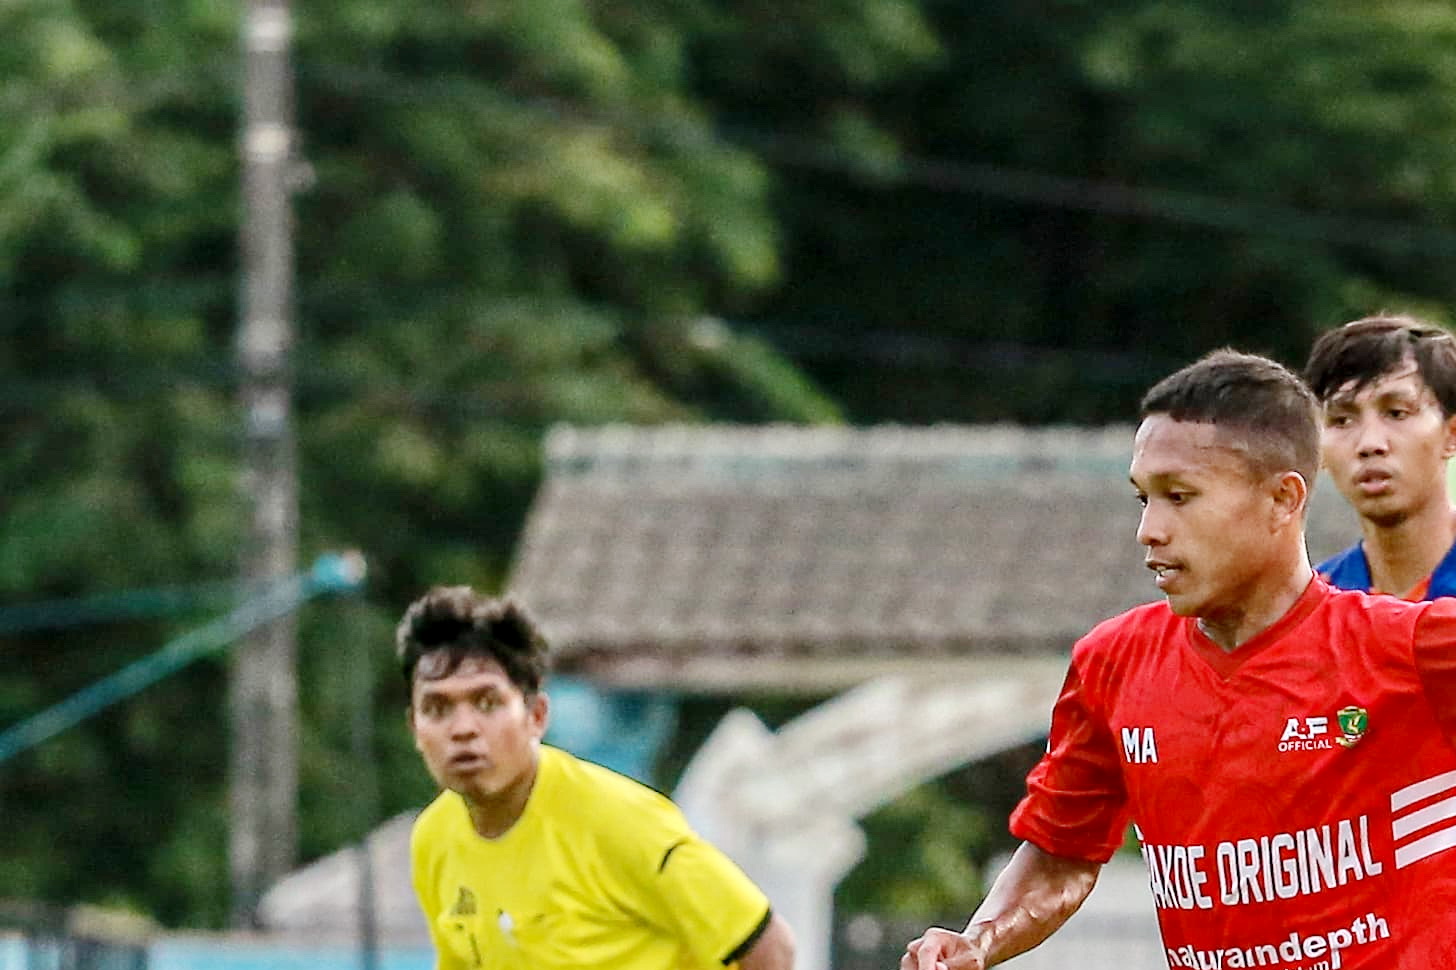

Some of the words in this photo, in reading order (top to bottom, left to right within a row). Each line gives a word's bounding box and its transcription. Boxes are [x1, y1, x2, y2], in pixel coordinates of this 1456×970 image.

[1121, 727, 1158, 764] MA
[1277, 739, 1333, 752] OFFICIAL
[1216, 814, 1383, 906] ORIGINAL
